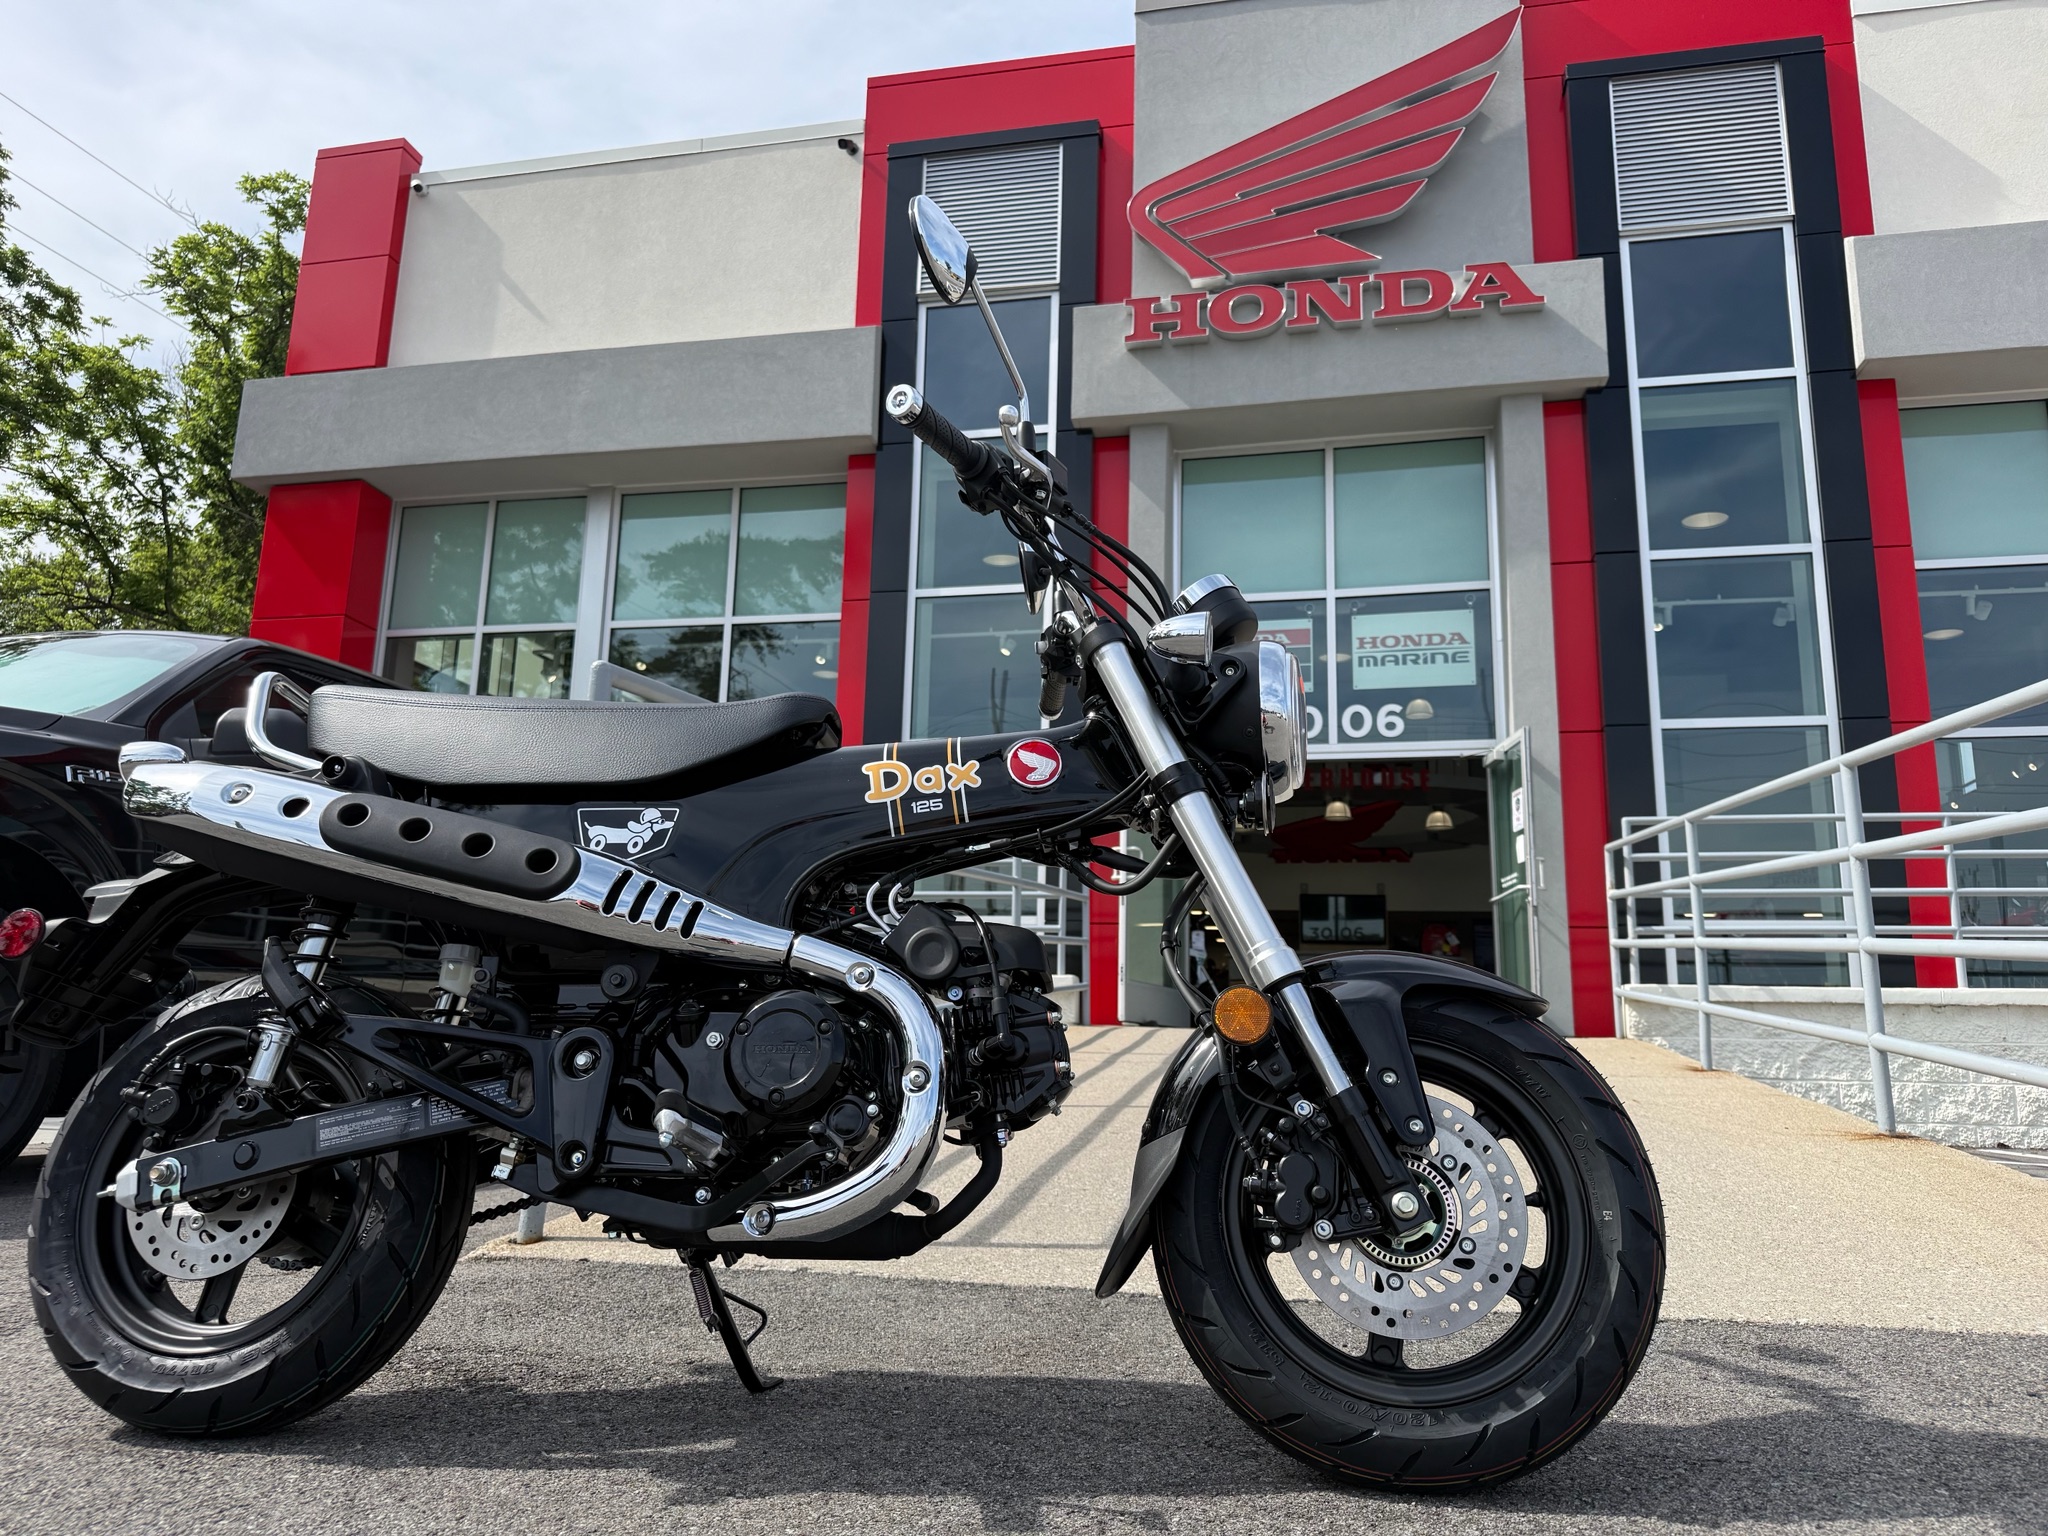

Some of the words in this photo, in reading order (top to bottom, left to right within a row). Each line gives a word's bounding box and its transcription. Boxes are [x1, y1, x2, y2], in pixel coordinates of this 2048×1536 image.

[1124, 262, 1546, 348] HONDA
[1356, 632, 1471, 650] HONDA
[861, 760, 982, 804] Dax
[911, 798, 943, 813] 125
[752, 1044, 811, 1054] HONDA
